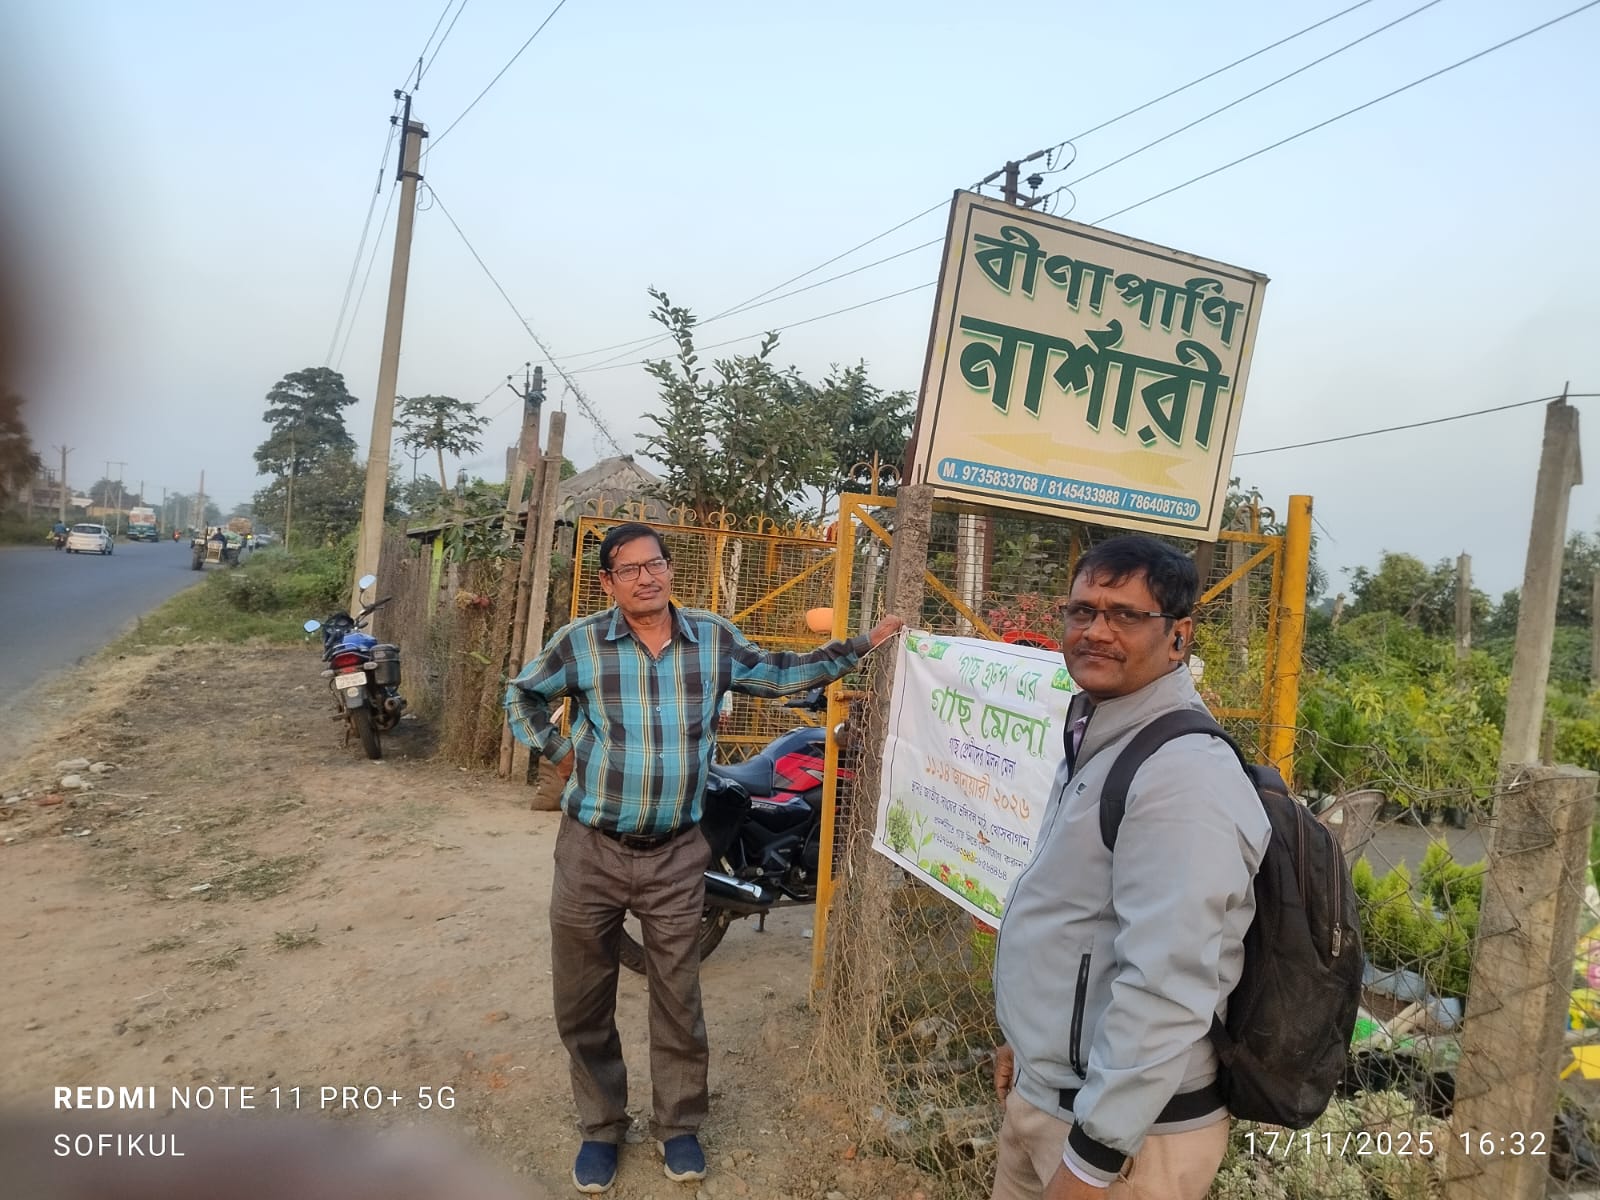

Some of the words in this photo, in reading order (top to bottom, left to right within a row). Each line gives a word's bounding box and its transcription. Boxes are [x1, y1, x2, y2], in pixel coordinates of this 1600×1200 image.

[973, 225, 1245, 348] বীণাপাণি
[942, 461, 958, 479] M.
[962, 465, 1038, 492] 9735833768
[1048, 480, 1120, 505] 8145433988
[1130, 494, 1197, 518] 7864087630
[1016, 671, 1042, 702] এর
[931, 685, 975, 738] গাছ
[981, 703, 1052, 760] মেলা
[993, 787, 1030, 820] ২০২৬
